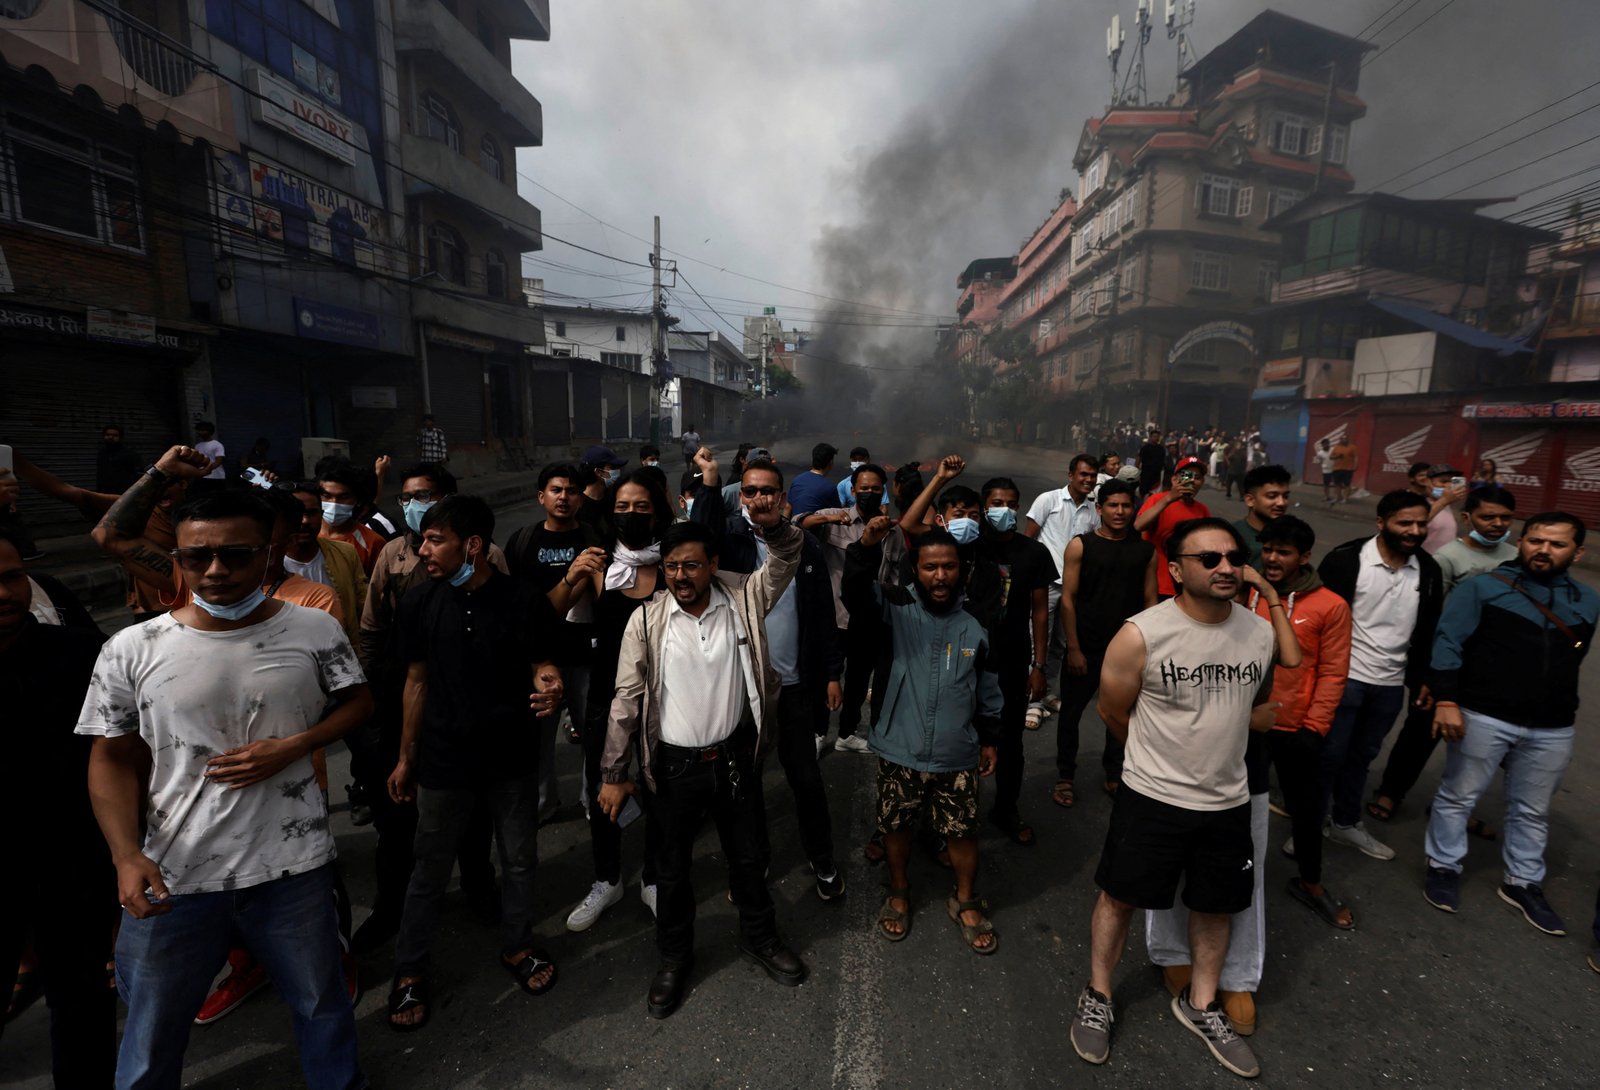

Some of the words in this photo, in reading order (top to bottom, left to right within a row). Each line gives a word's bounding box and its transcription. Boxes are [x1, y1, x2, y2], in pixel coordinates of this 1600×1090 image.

[293, 100, 349, 141] IVORY
[1382, 462, 1411, 473] HON
[1502, 473, 1542, 487] NDA
[1160, 658, 1262, 689] HEATRMAN
